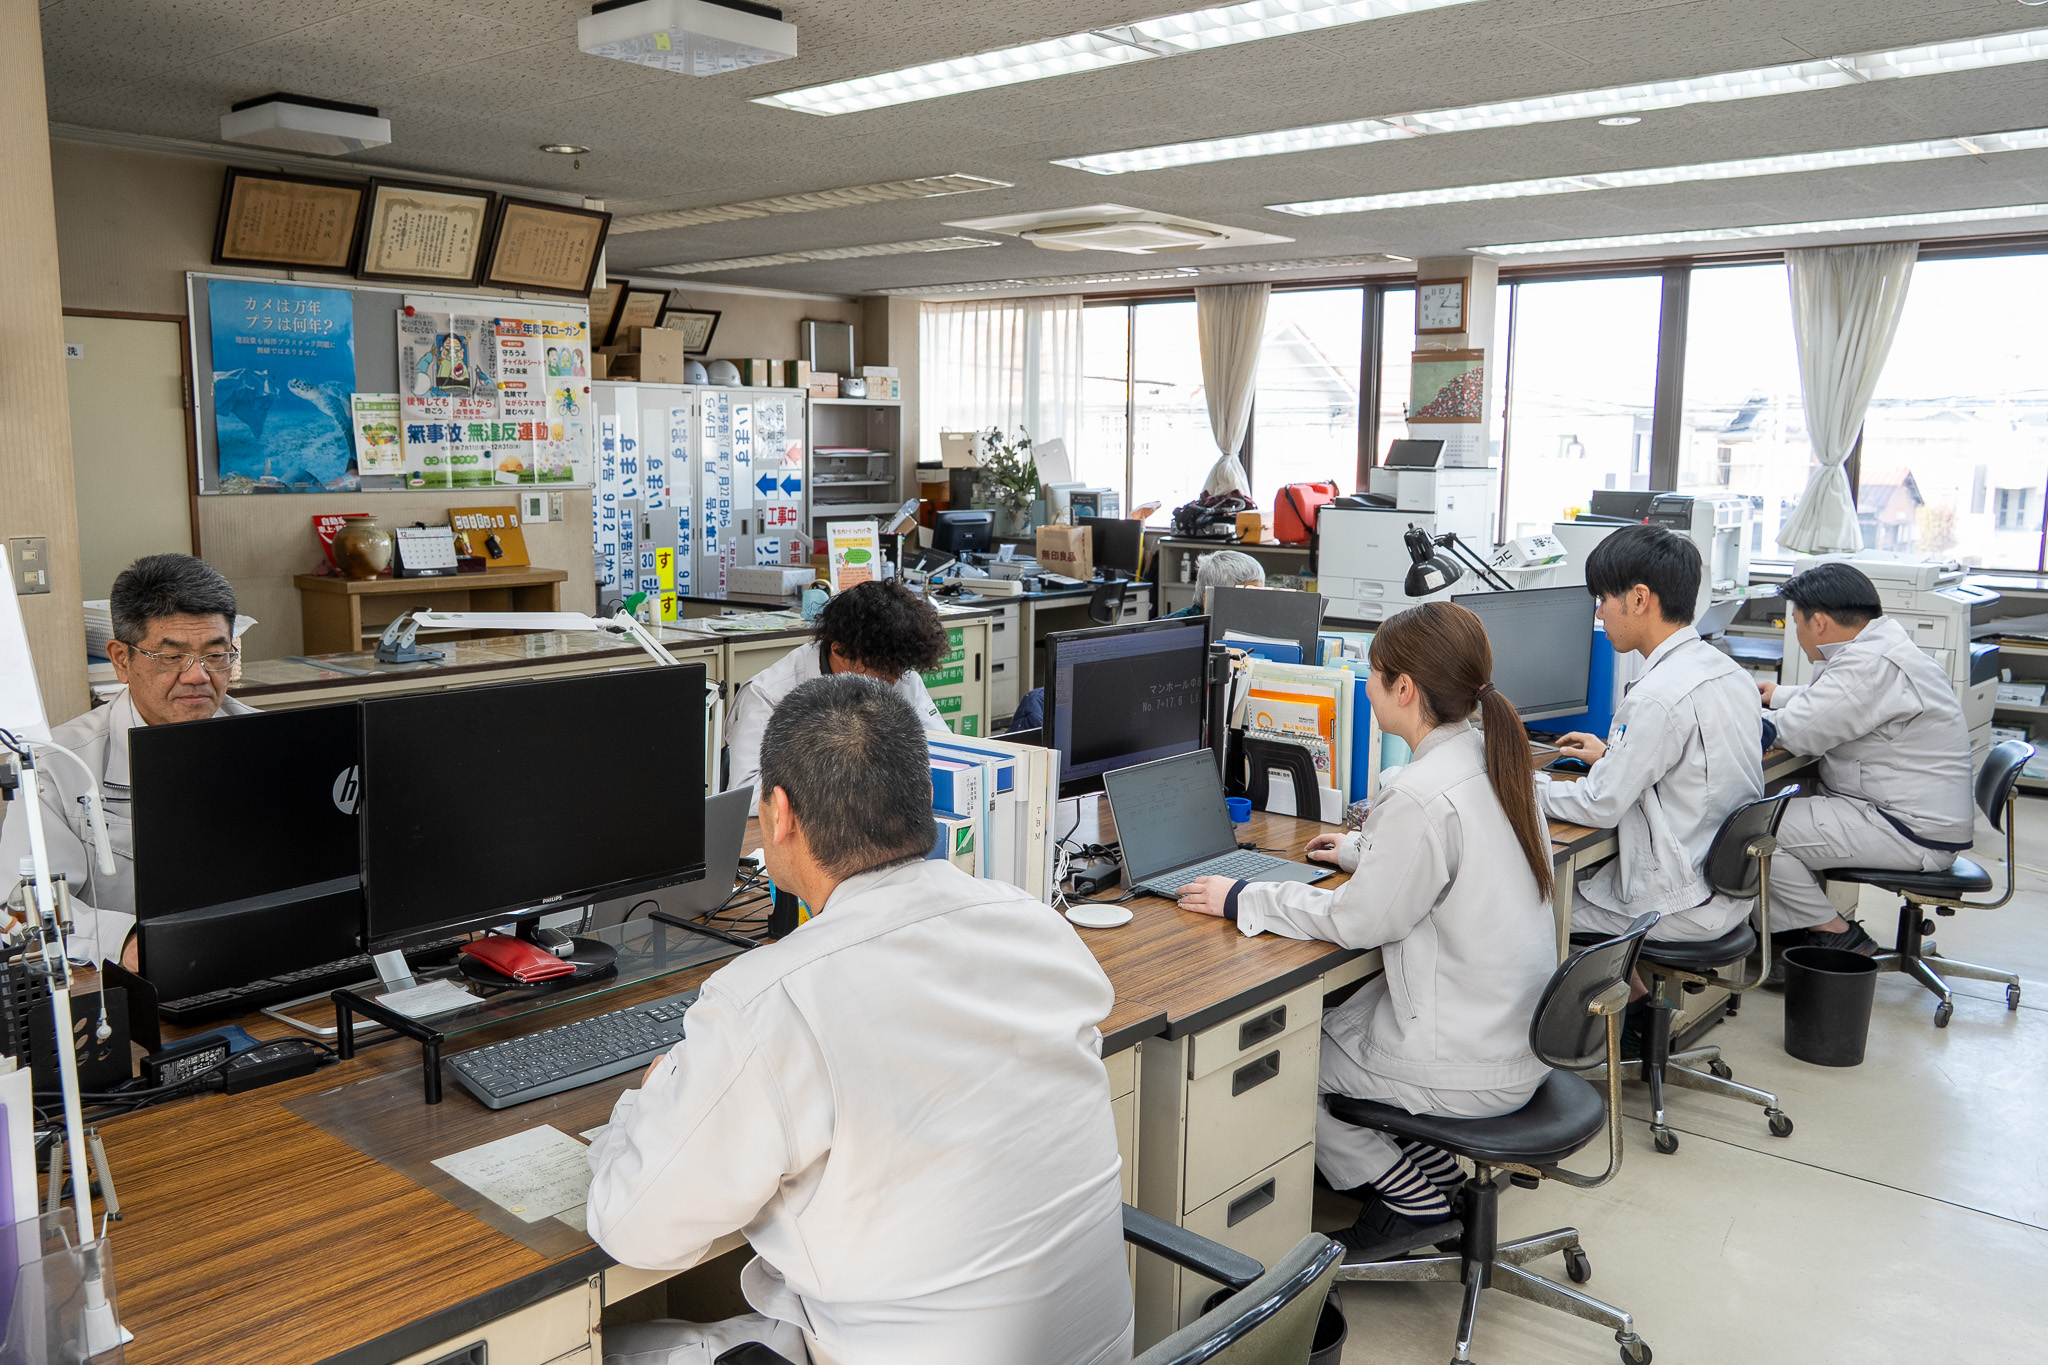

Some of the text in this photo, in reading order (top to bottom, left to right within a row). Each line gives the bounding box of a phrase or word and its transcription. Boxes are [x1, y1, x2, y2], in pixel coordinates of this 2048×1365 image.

[244, 297, 322, 316] カメは万年
[245, 314, 333, 336] プラは何年?
[522, 323, 581, 336] 年間スローガン
[67, 346, 78, 356] 洗
[502, 349, 527, 357] 守ろうよ
[503, 367, 528, 375] 子の未来
[407, 397, 449, 407] 後悔しても
[504, 390, 528, 398] 危険です
[671, 409, 688, 463] います
[735, 406, 750, 467] います
[620, 433, 637, 498] います
[646, 454, 664, 509] います
[767, 506, 797, 526] 工事中
[641, 553, 654, 568] 30
[658, 551, 671, 569] す
[1041, 549, 1077, 563] 無印良品
[661, 596, 674, 614] す
[542, 895, 563, 904] PHILIPS
